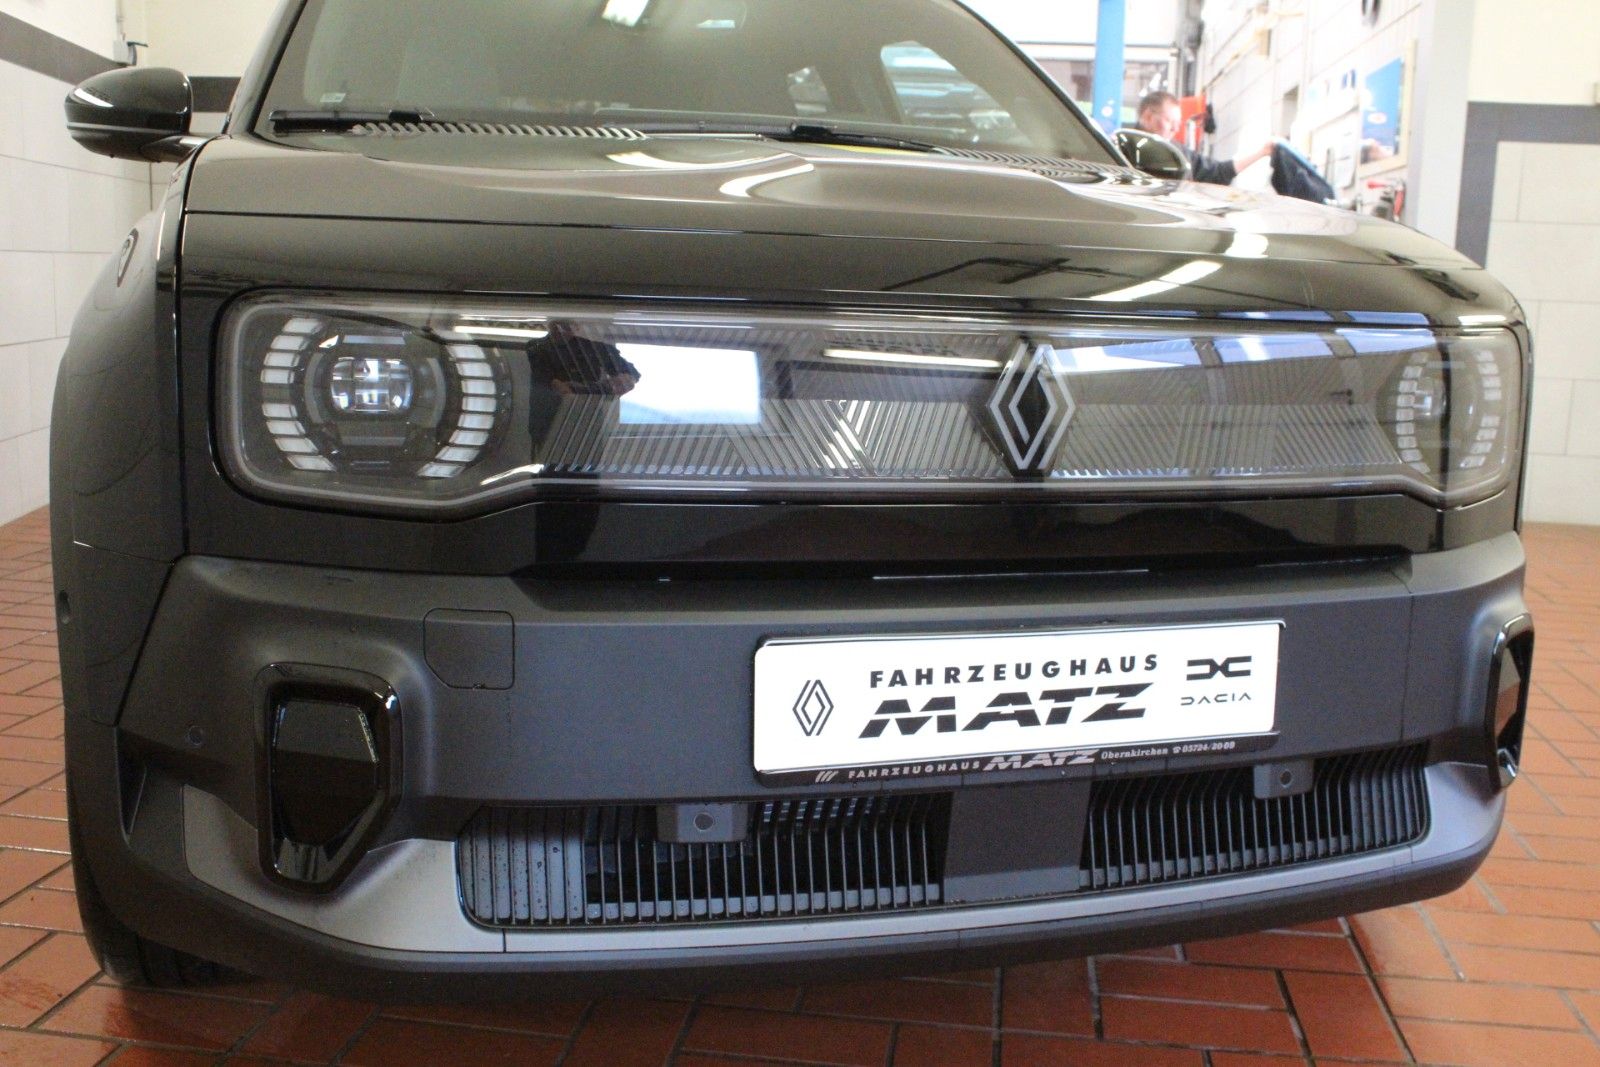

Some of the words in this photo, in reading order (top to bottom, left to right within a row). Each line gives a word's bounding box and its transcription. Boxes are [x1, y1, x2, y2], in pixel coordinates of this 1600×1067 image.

[869, 653, 1158, 688] FAHRZEUGHAUS
[858, 682, 1155, 739] MATZ
[1180, 691, 1252, 706] DACIA
[847, 760, 981, 779] FAHRZEUGHAUS
[982, 749, 1099, 771] MATZ
[1101, 748, 1168, 760] Obernkirchen
